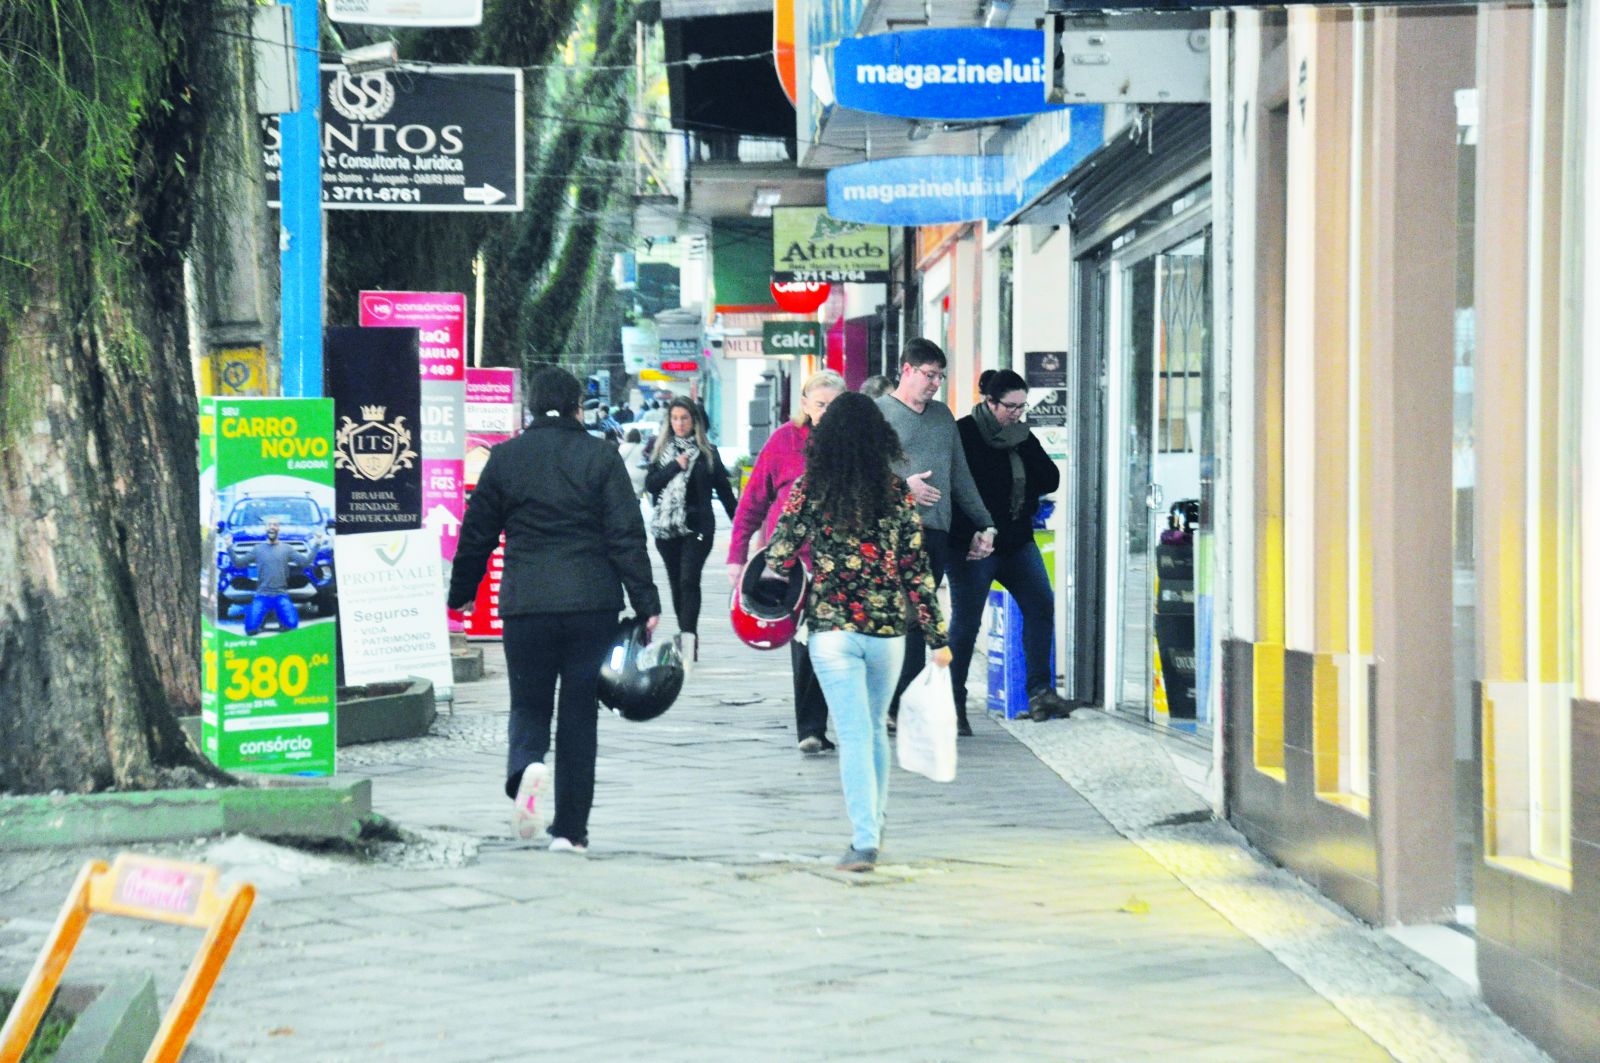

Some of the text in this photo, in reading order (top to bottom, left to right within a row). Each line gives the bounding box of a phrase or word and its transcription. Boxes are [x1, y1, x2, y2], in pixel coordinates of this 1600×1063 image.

[262, 116, 463, 154] SNTOS
[339, 152, 410, 171] Consultoria
[333, 186, 420, 201] 3711-6761
[727, 339, 763, 352] MULT
[771, 330, 815, 348] calci
[221, 416, 298, 438] CARRO
[261, 437, 329, 458] NOVO
[356, 435, 393, 450] ITS
[349, 502, 400, 511] TRINDADE
[353, 607, 419, 623] Seguros
[360, 626, 387, 635] VIDA
[240, 735, 313, 755] consórcio
